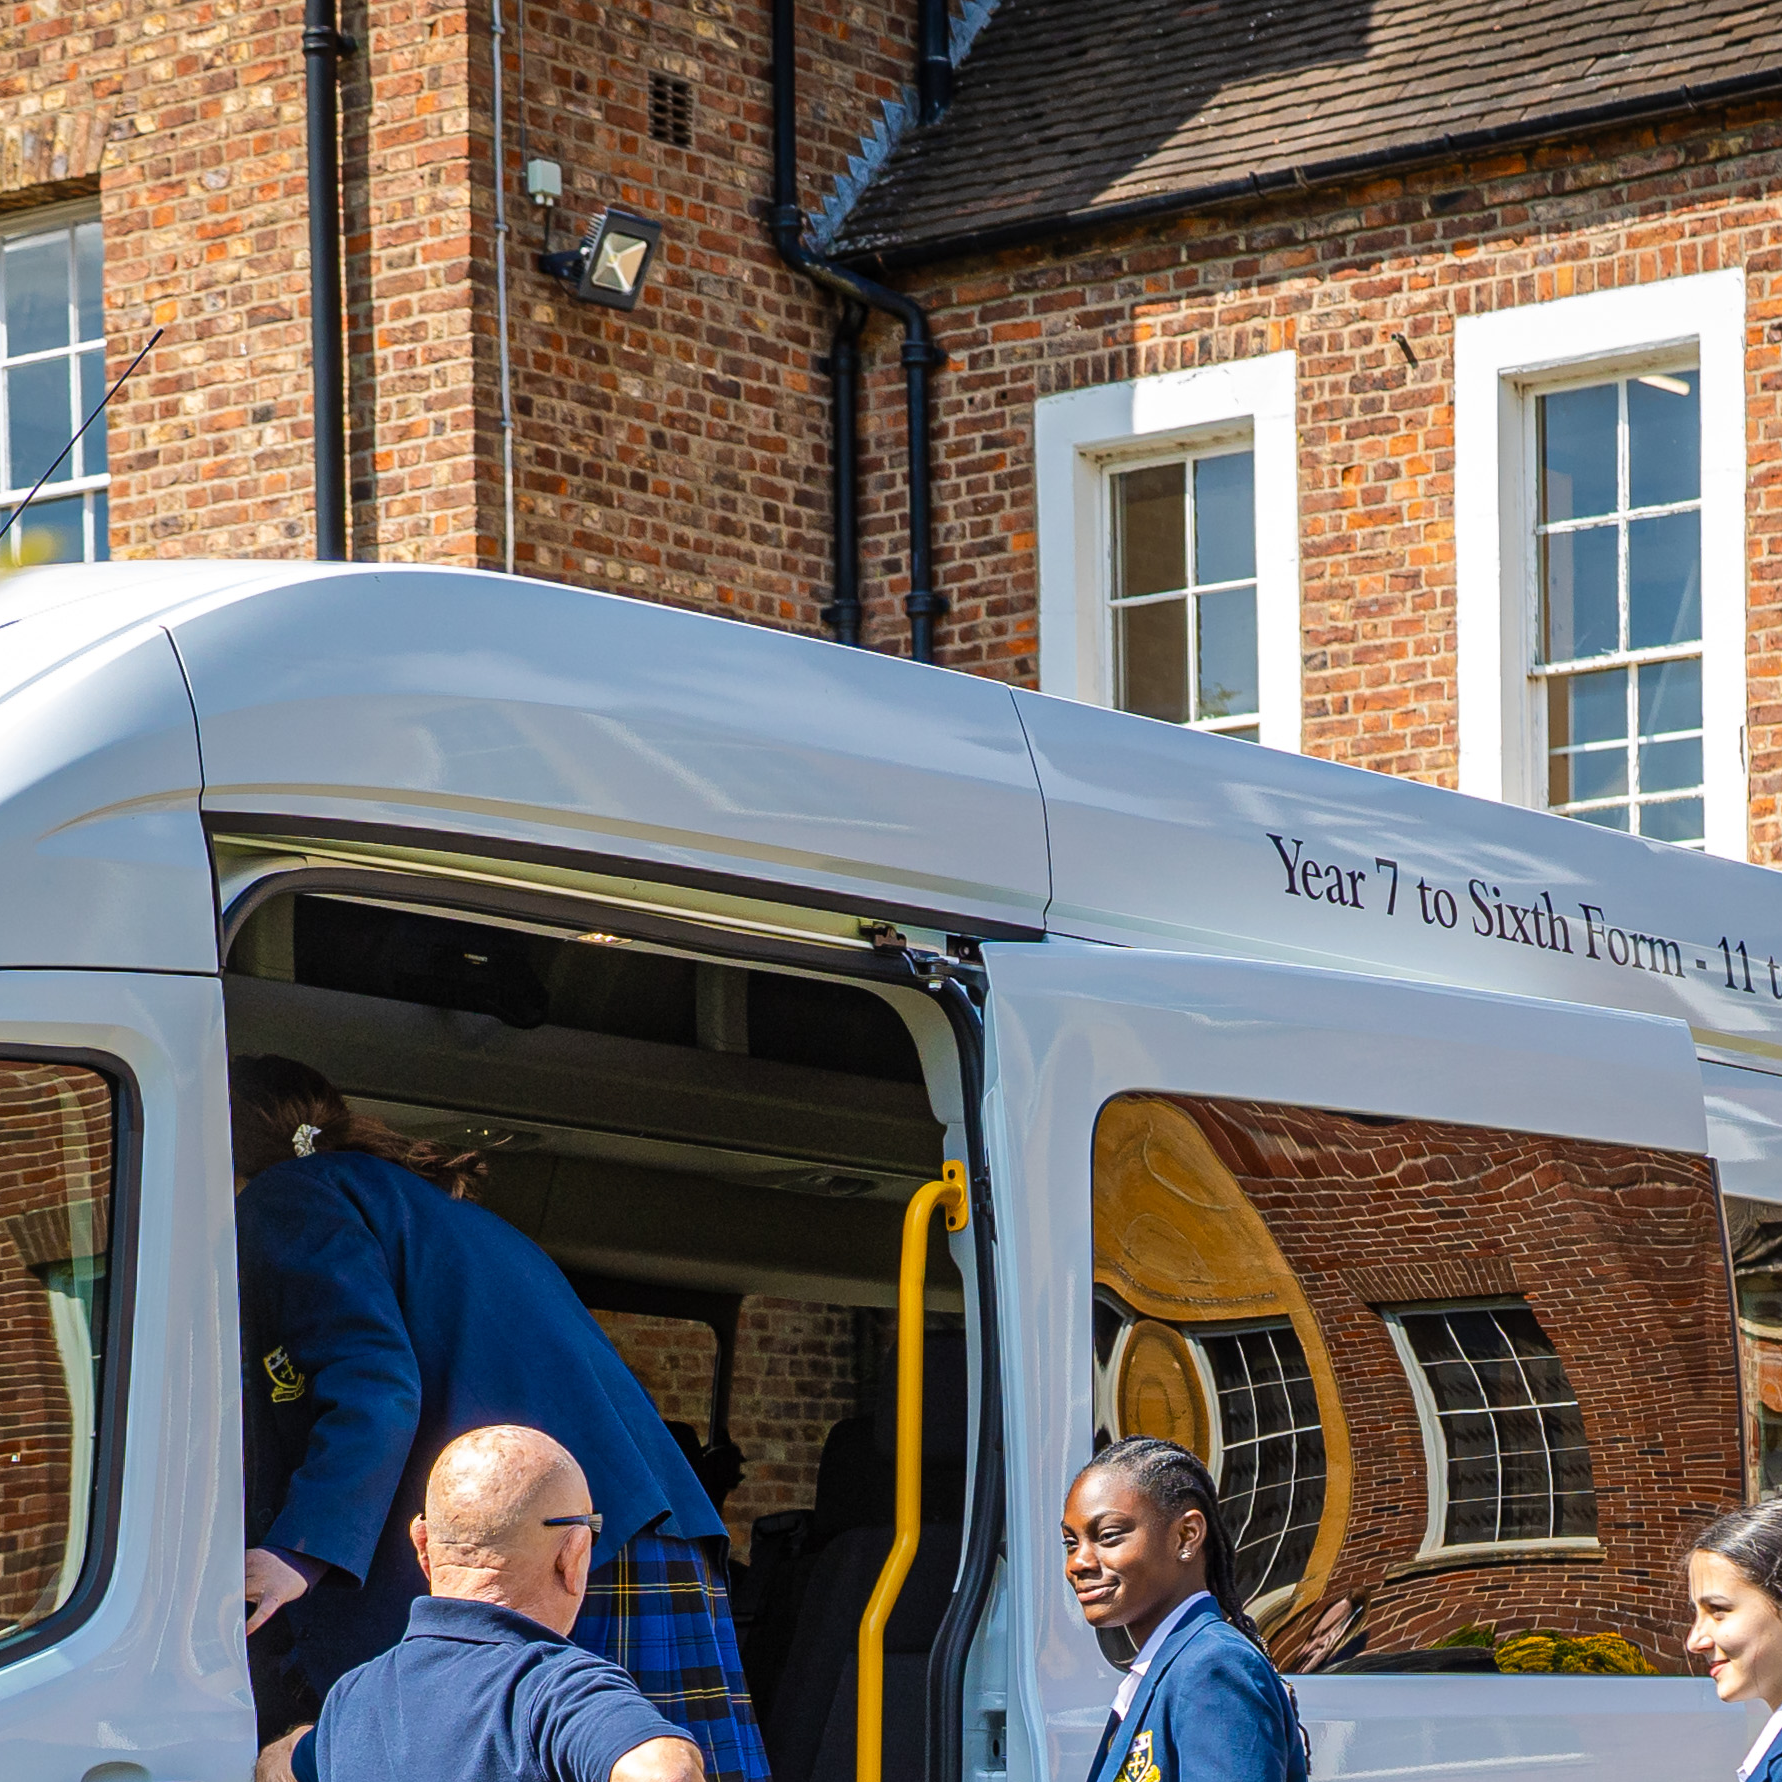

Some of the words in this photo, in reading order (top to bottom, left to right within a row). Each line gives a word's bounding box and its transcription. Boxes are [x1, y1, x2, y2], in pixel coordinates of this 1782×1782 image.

[1266, 833, 1366, 911] Year
[1375, 858, 1399, 916] 7
[1417, 877, 1459, 929] to
[1469, 878, 1574, 954] Sixth
[1578, 903, 1686, 978] Form
[1696, 959, 1707, 970] -
[1718, 936, 1756, 993] 11
